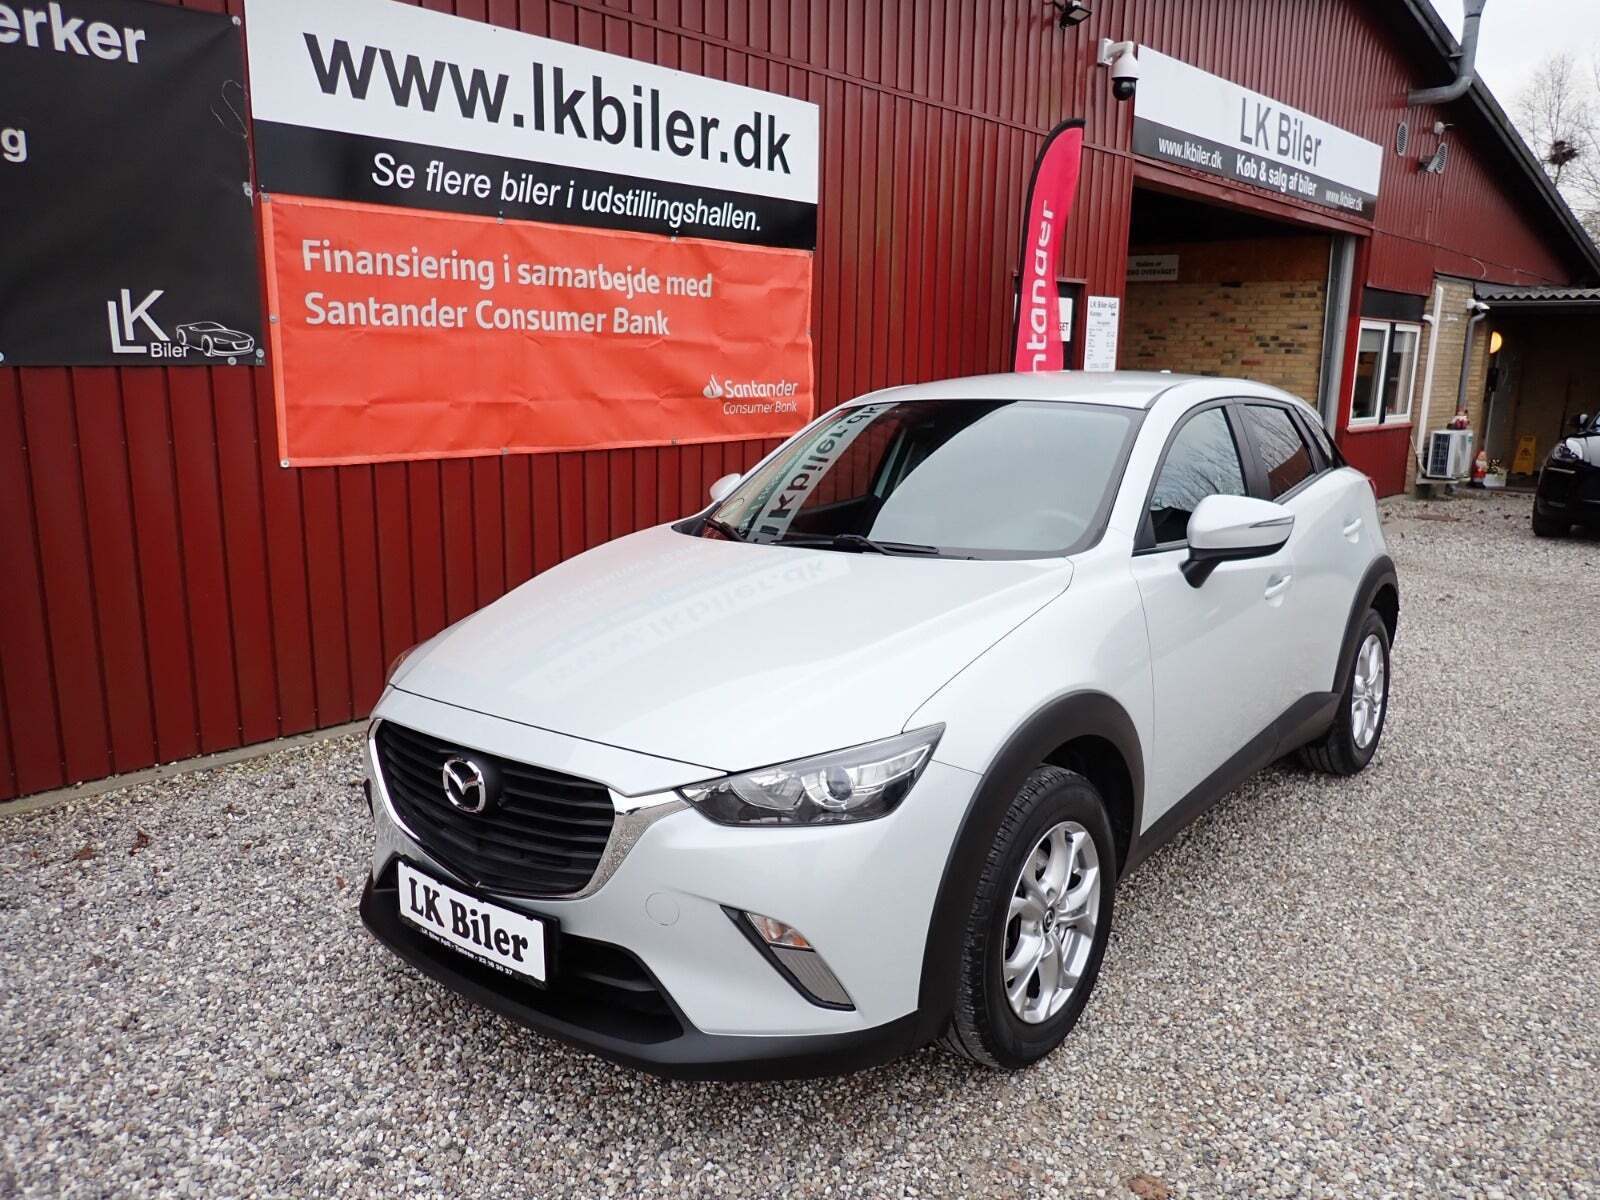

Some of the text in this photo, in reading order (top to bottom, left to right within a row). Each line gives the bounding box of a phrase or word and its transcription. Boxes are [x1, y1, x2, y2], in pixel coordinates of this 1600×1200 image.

[303, 32, 791, 174] www.lkbiler.dk
[1240, 97, 1321, 167] LK Biler
[371, 152, 761, 231] Se flere biler i udstillingshallen.
[1158, 138, 1223, 170] www.lkbiler.dk
[1236, 154, 1258, 179] Køb
[1259, 161, 1267, 182] &
[1268, 167, 1288, 193] salg
[1289, 172, 1298, 191] af
[1298, 174, 1317, 196] biler
[302, 239, 713, 299] Finansiering i samarbejde med
[107, 288, 189, 358] LK Biler
[305, 291, 670, 335] Santander Consumer Bank
[723, 400, 797, 415] Consumer Bank
[725, 380, 799, 399] Santander
[408, 877, 528, 963] LK Biler
